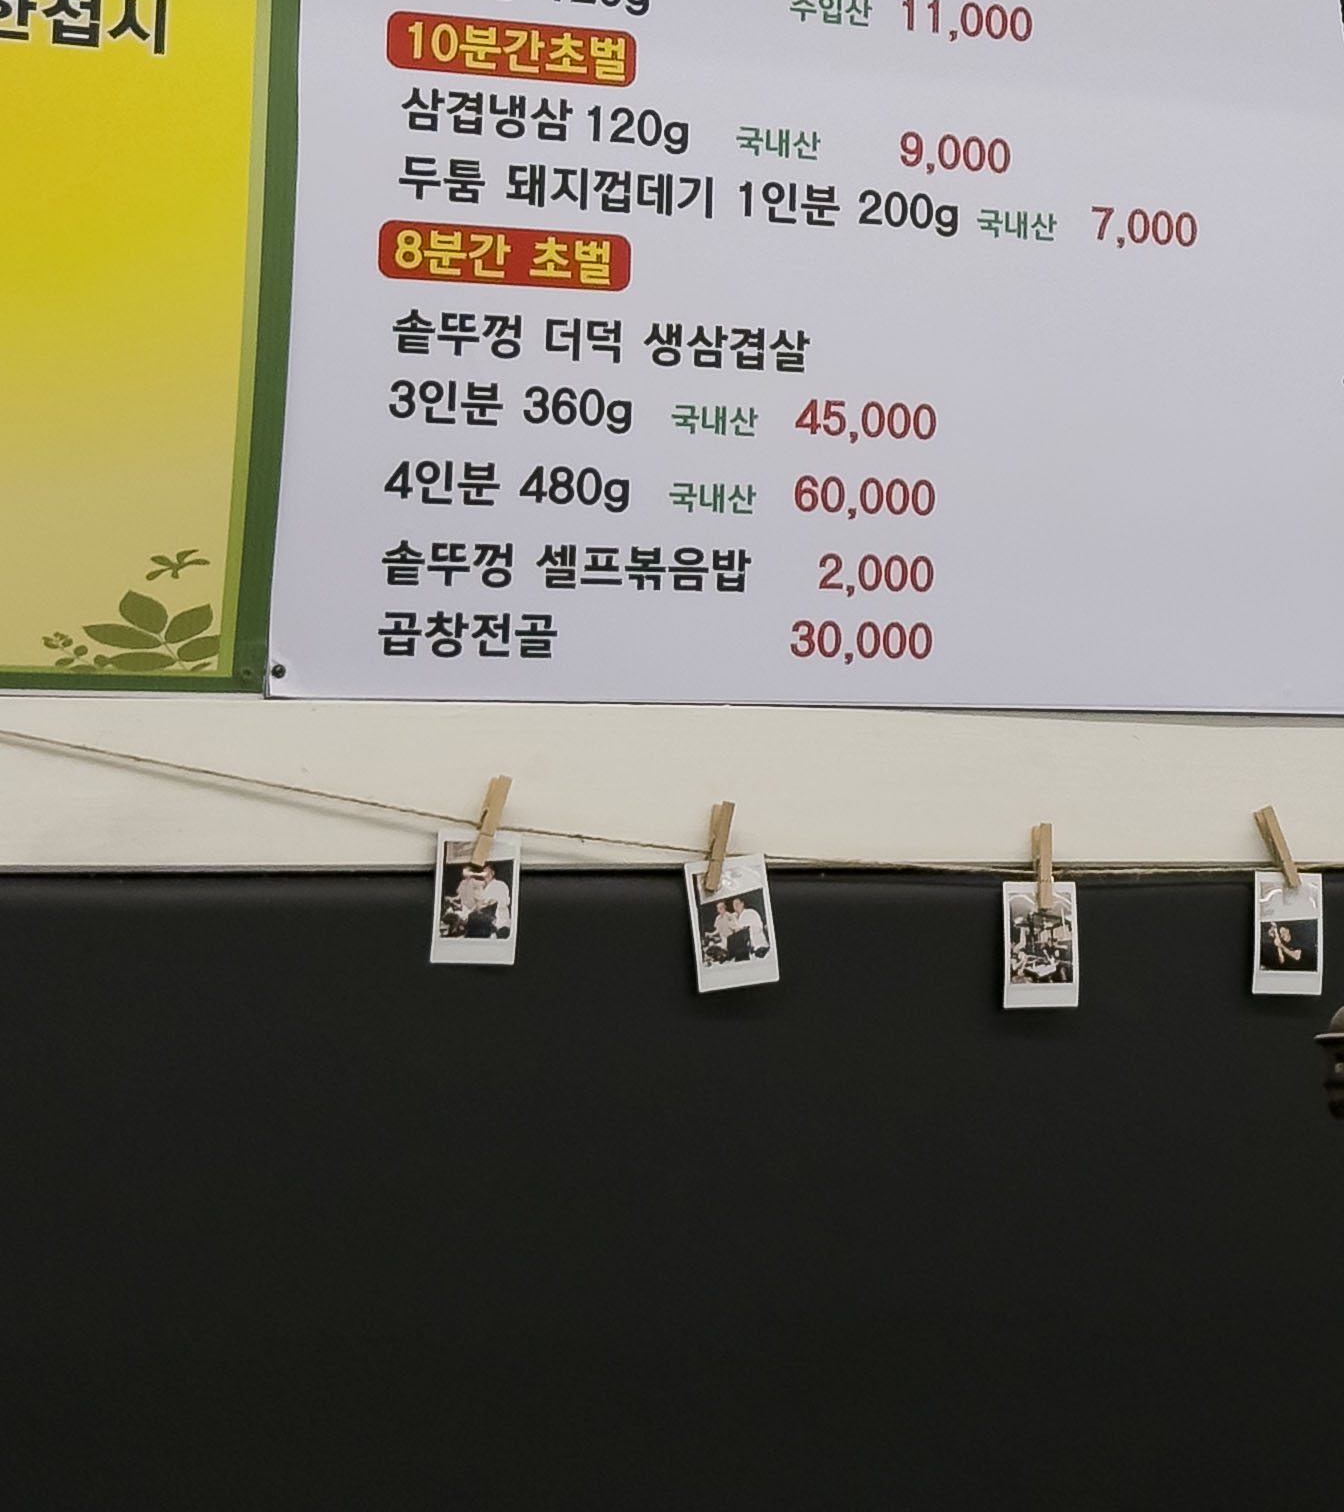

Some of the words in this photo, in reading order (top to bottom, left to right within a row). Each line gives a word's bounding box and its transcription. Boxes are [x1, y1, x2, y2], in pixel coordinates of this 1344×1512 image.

[406, 20, 627, 83] 10분간초벌
[401, 87, 573, 142] 삼겹냉삼
[587, 105, 688, 155] 120g
[736, 127, 821, 160] 국내산
[900, 131, 1011, 175] 9,000
[399, 156, 486, 204] 두툼
[506, 164, 713, 219] 돼지껍데기
[739, 180, 840, 227] 1인분
[858, 189, 958, 237] 200g
[977, 209, 1057, 241] 국내산
[1092, 206, 1197, 248] 7,000
[395, 229, 511, 277] 8분간
[529, 238, 612, 285] 초벌
[392, 309, 522, 359] 솥뚜껑
[545, 318, 621, 364] 더덕
[643, 323, 810, 373] 생삼겹살
[389, 379, 504, 426] 3인분
[523, 386, 632, 434] 360g
[671, 405, 758, 436] 국내산
[795, 399, 936, 444] 45,000
[384, 460, 501, 506] 4인분
[519, 466, 629, 513] 480g
[669, 483, 756, 514] 국내산
[795, 475, 935, 520] 60,000
[382, 540, 513, 588] 솥뚜껑
[536, 544, 752, 592] 셀프볶음밥
[819, 553, 934, 598] 2,000
[378, 611, 558, 658] 곱창전골
[790, 620, 932, 665] 30,000
